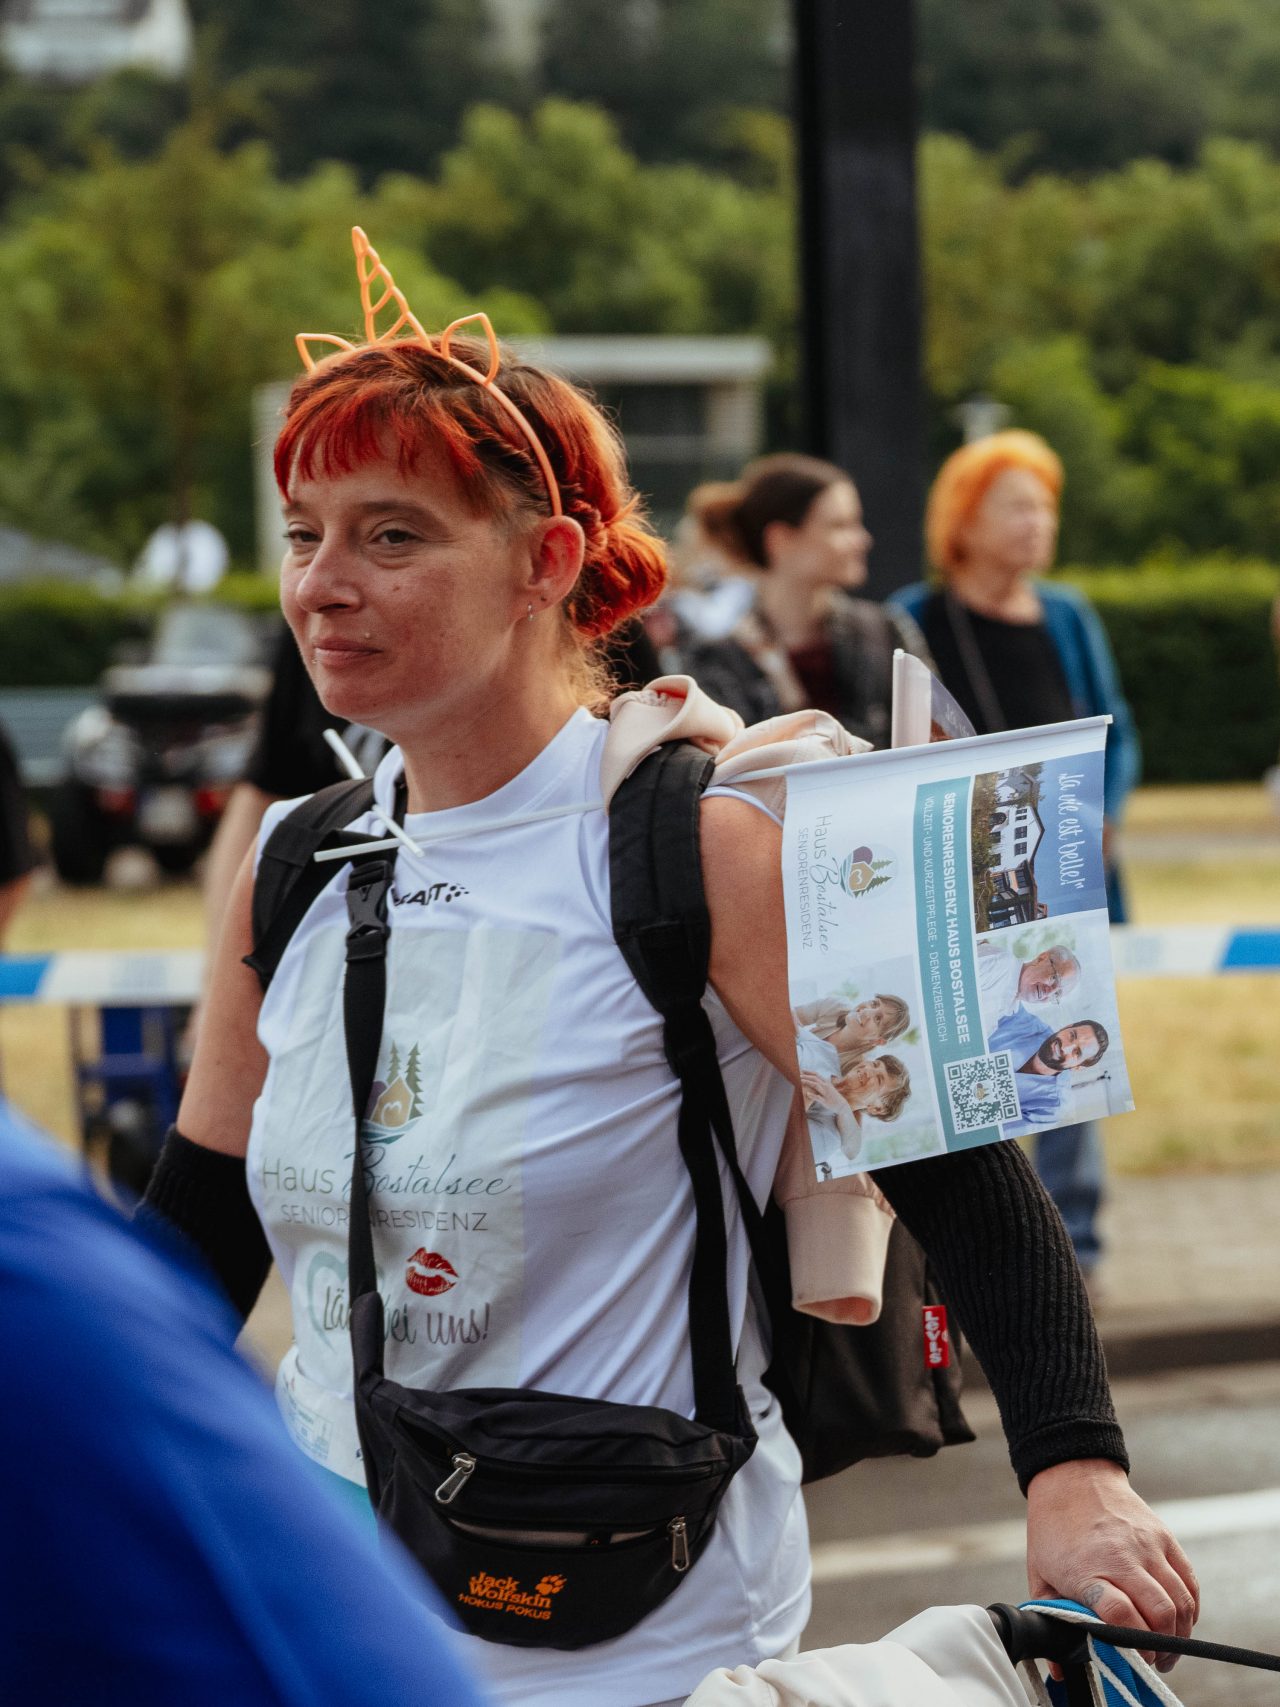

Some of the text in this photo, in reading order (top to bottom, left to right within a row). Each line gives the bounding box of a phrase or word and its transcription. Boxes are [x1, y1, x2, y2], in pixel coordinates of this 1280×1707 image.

[1058, 794, 1083, 815] vie
[923, 837, 933, 857] UND
[1059, 818, 1083, 840] est
[798, 827, 812, 950] SENIORENRESIDENZ
[809, 815, 839, 953] Haus Bostalsee
[924, 858, 937, 942] KURZZEITPFLEGE
[942, 792, 970, 1043] SENIORENRESIDENZ HAUS BOSTALSEE
[929, 952, 948, 1042] DEMENZBEREICH
[263, 1157, 336, 1195] Haus
[427, 1302, 490, 1345] uns!
[469, 1581, 552, 1609] Wolfskin
[470, 1571, 520, 1592] Jack
[457, 1593, 552, 1621] HOKUS POKUS
